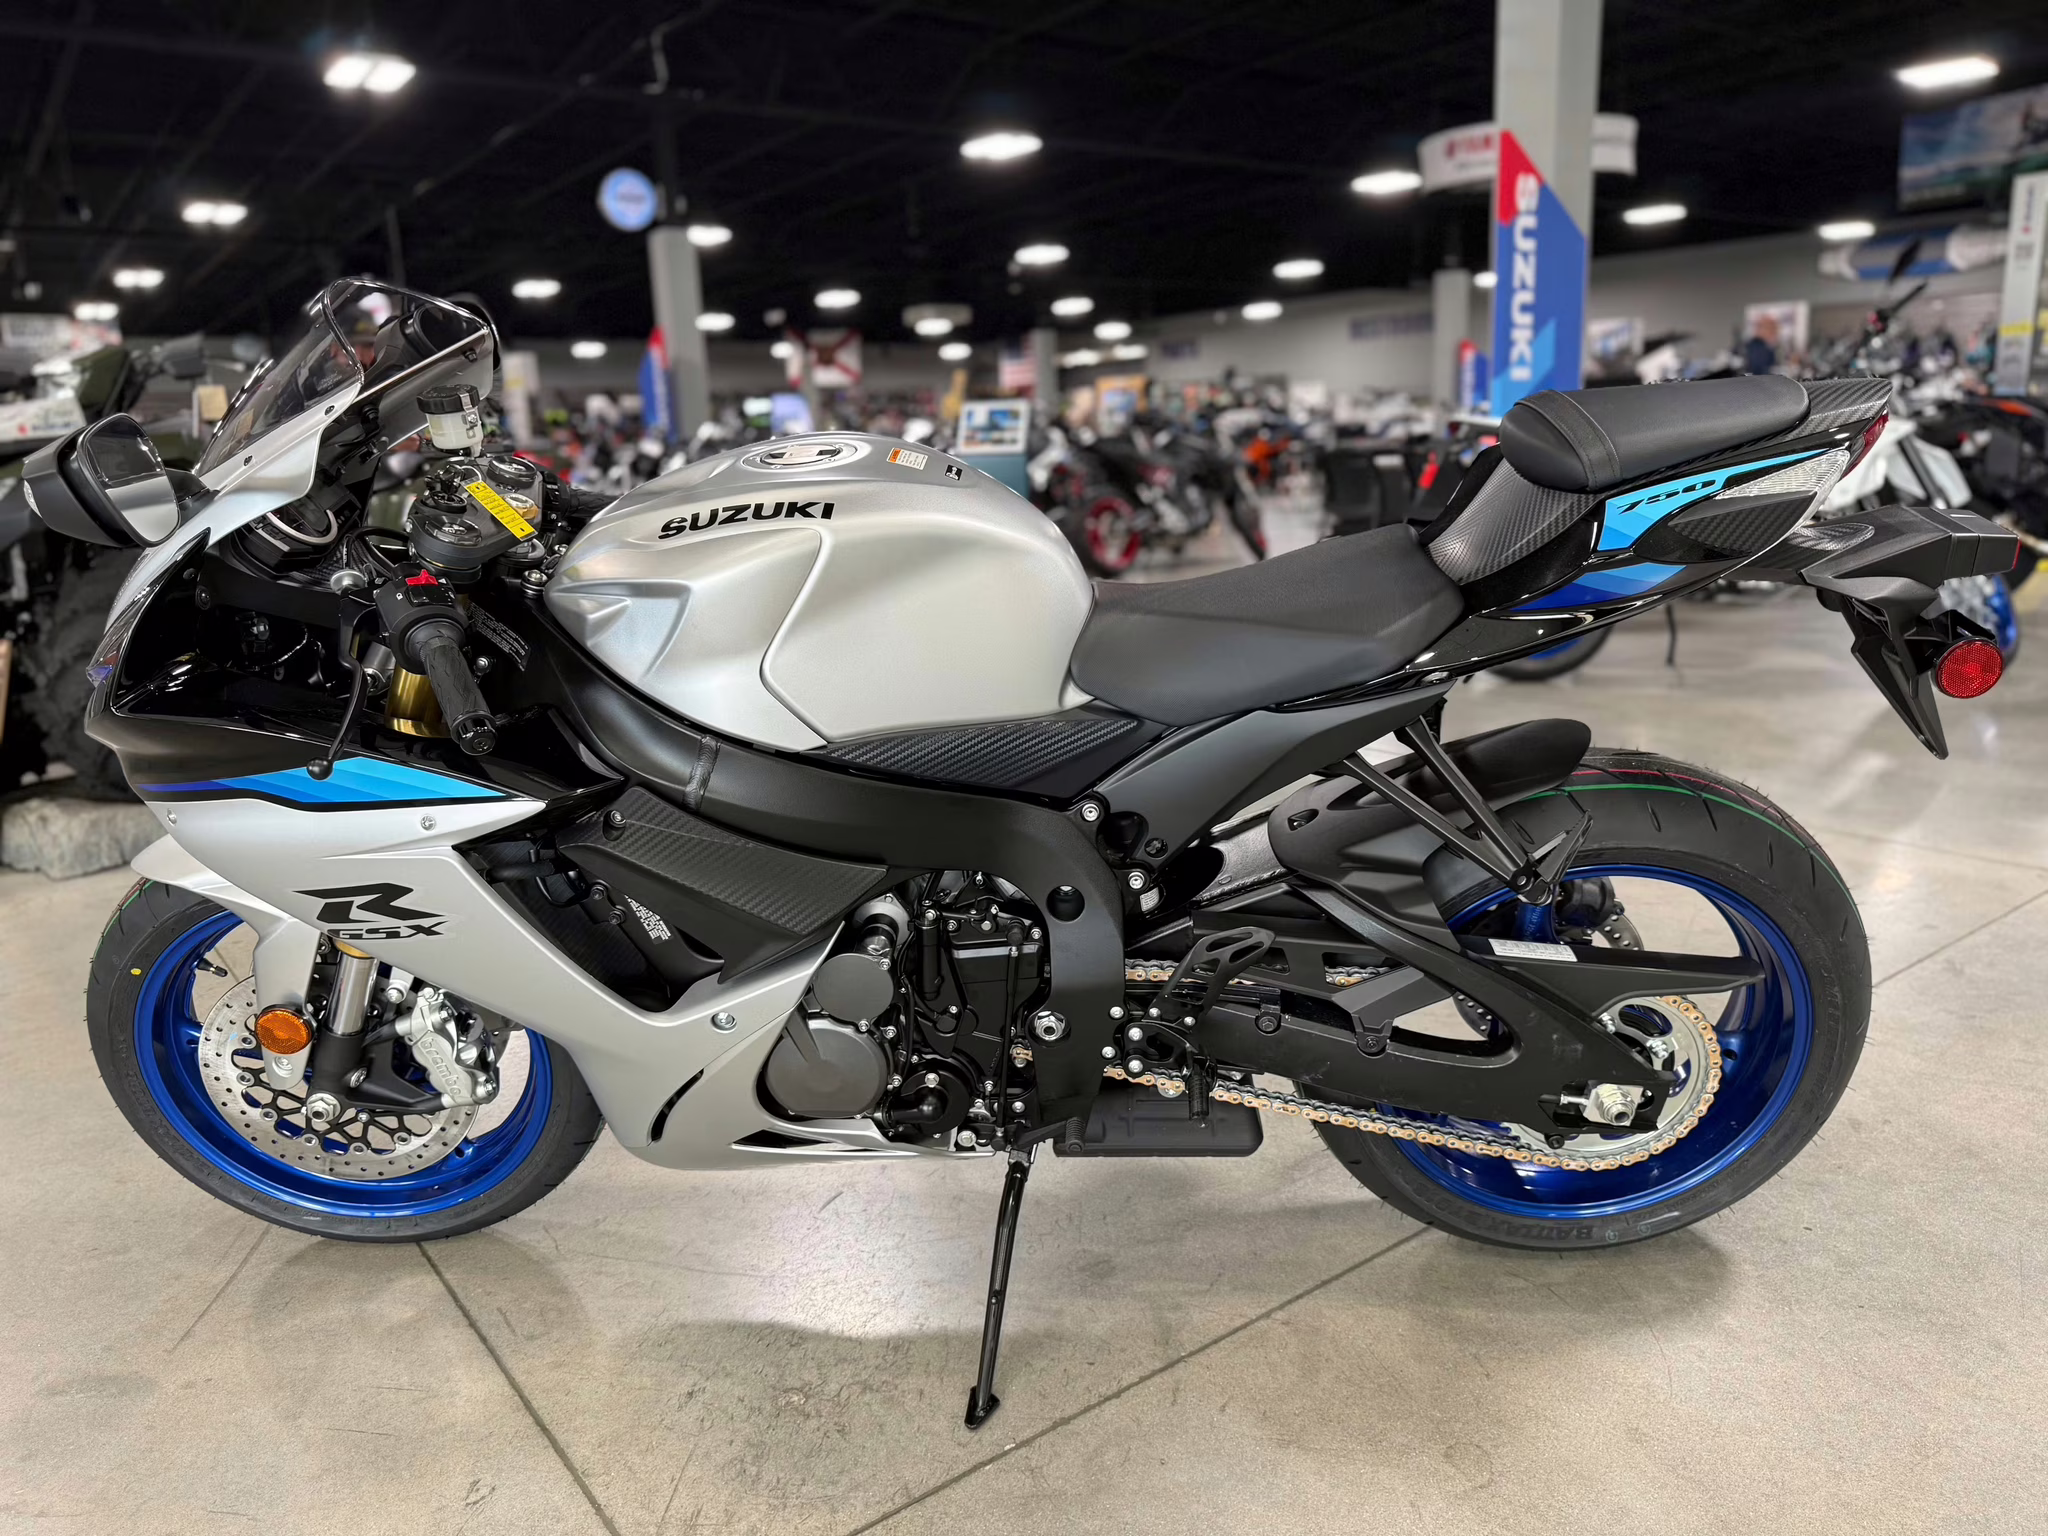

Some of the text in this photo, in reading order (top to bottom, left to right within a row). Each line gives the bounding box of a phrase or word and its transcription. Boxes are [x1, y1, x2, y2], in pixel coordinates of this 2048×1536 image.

[1508, 171, 1541, 383] SUZUKI
[1616, 479, 1717, 516] 750
[657, 501, 836, 540] SUZUKI
[291, 882, 446, 925] R
[326, 920, 449, 941] GSX
[419, 1036, 462, 1096] brembo
